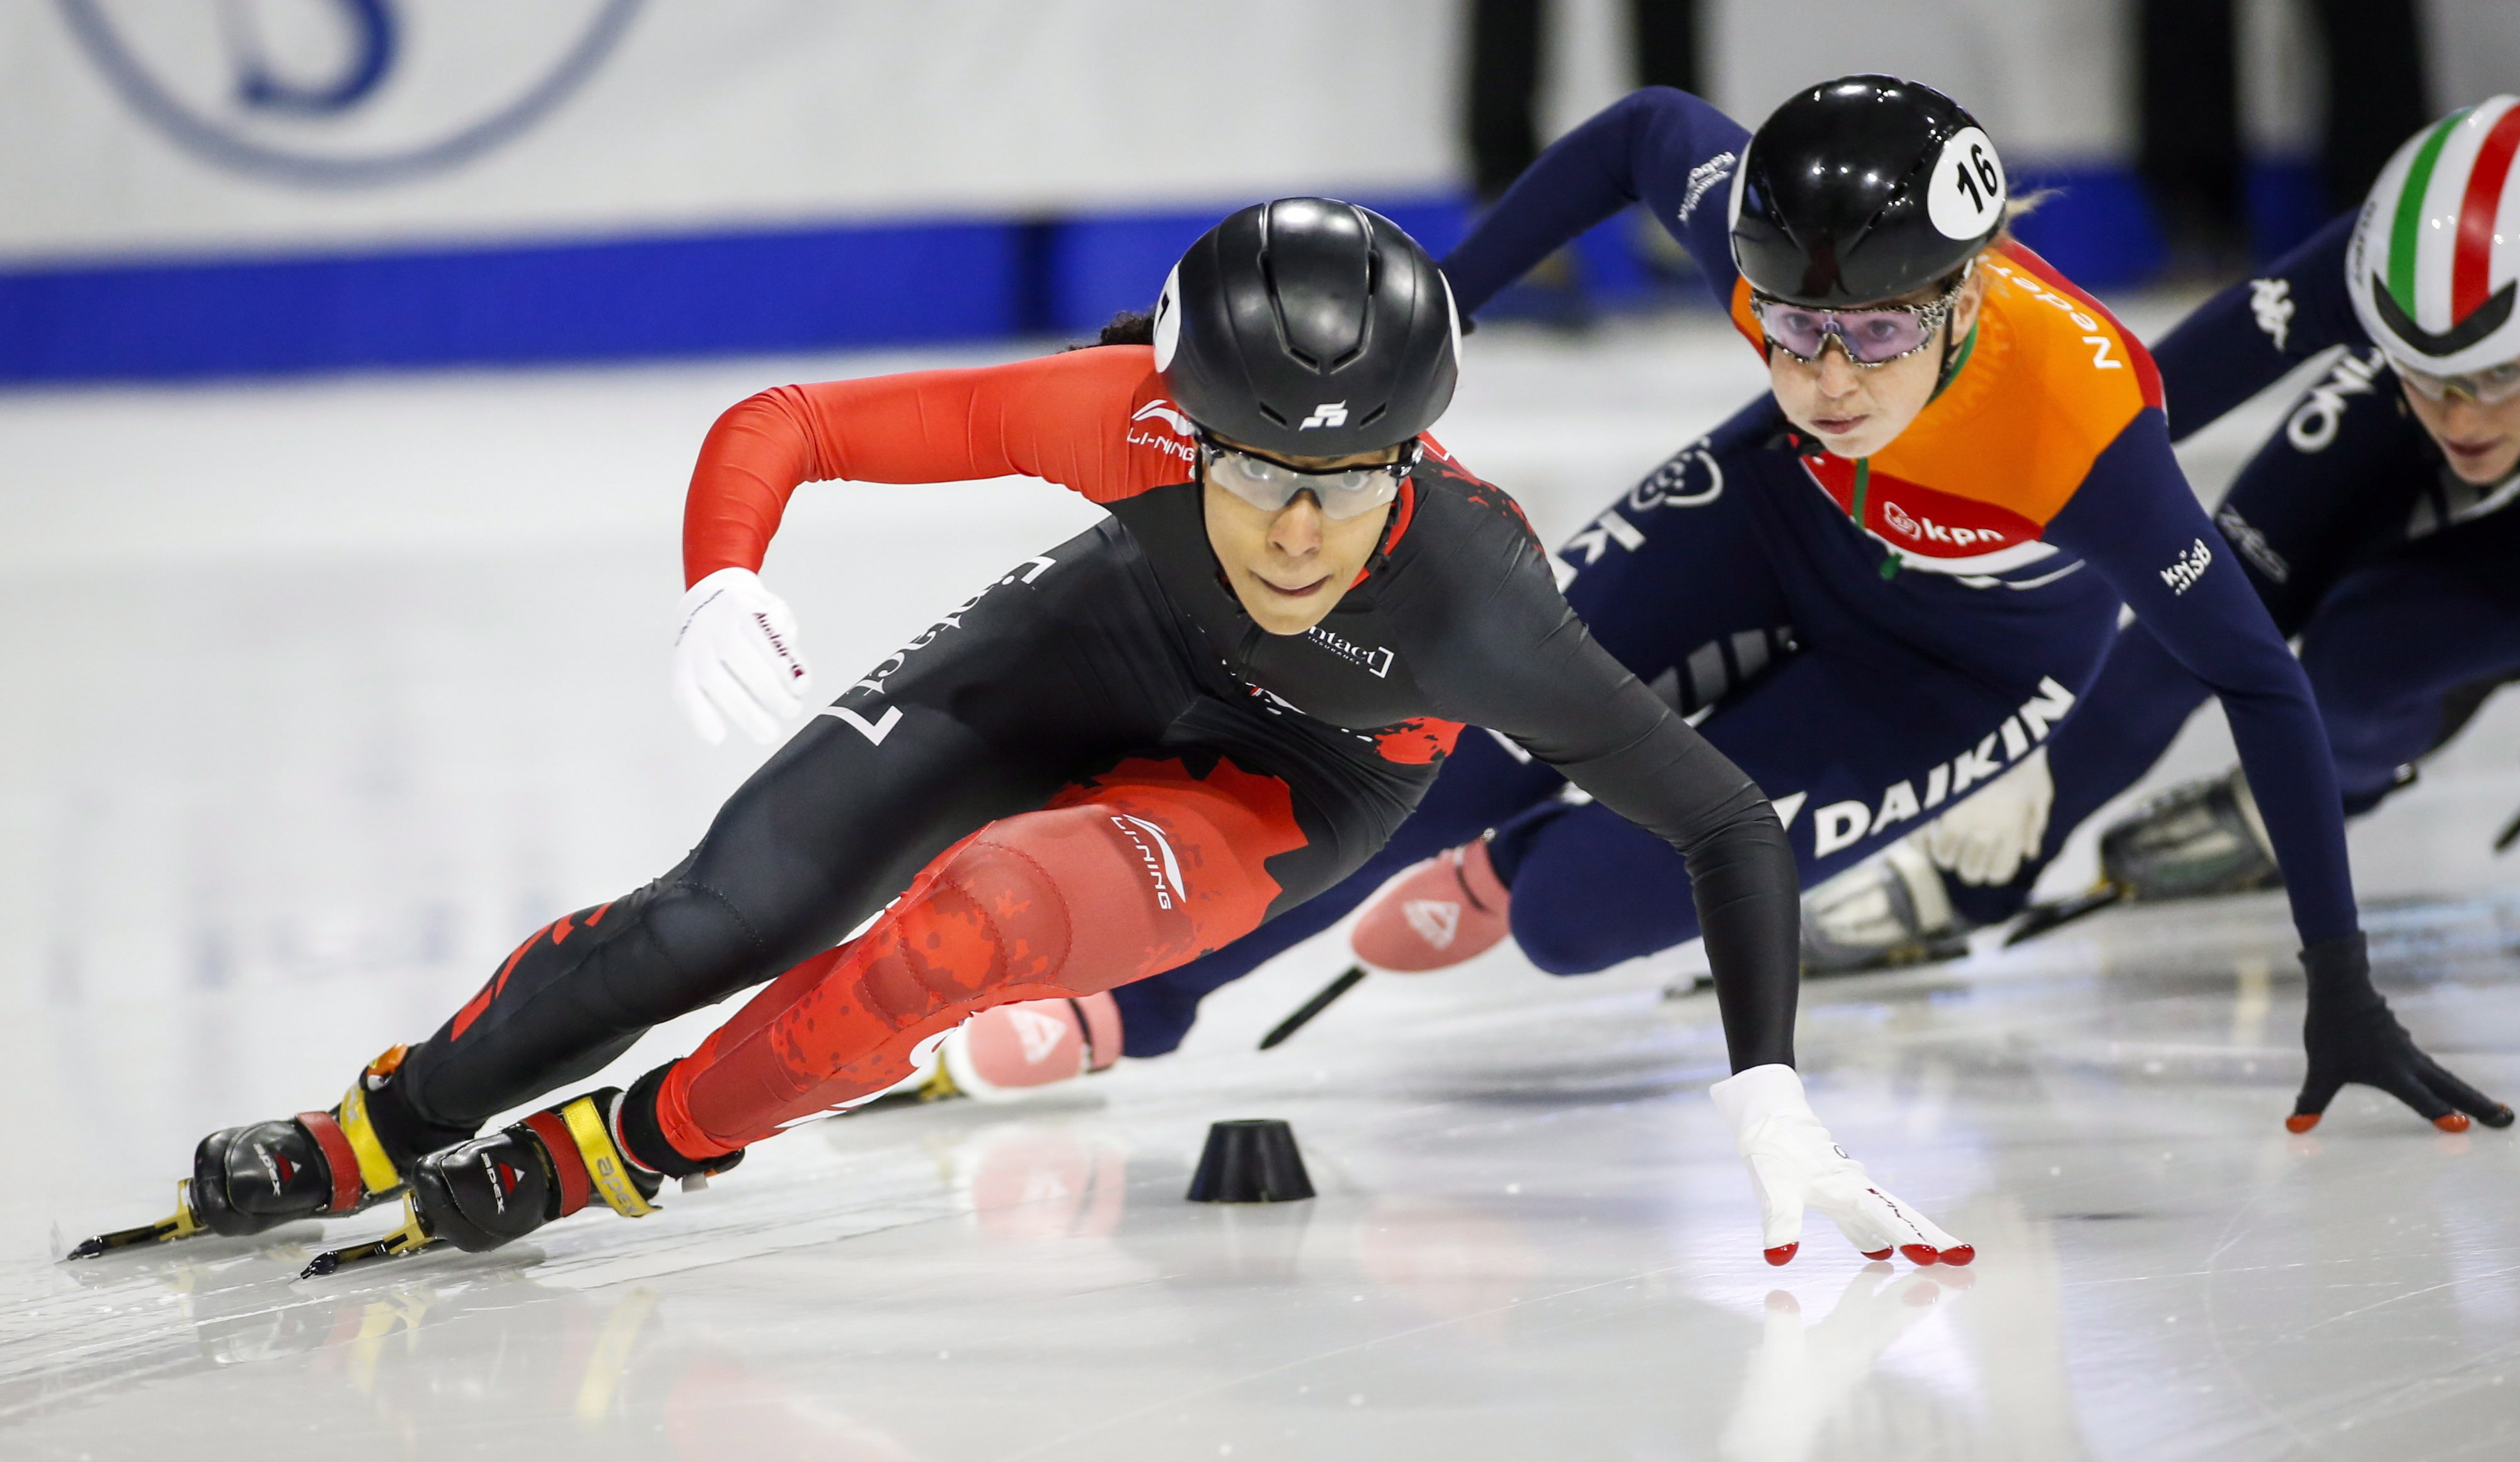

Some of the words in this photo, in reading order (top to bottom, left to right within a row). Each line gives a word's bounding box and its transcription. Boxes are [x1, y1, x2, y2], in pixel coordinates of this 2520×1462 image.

[1956, 143, 1997, 214] 16
[1126, 427, 1195, 462] LI-NING
[1922, 517, 2005, 547] kpn
[1813, 675, 2076, 860] DAIKIN
[1110, 816, 1172, 910] LI-NING
[253, 1143, 282, 1197] apex
[481, 1153, 505, 1215] apex
[596, 1155, 641, 1215] apex
